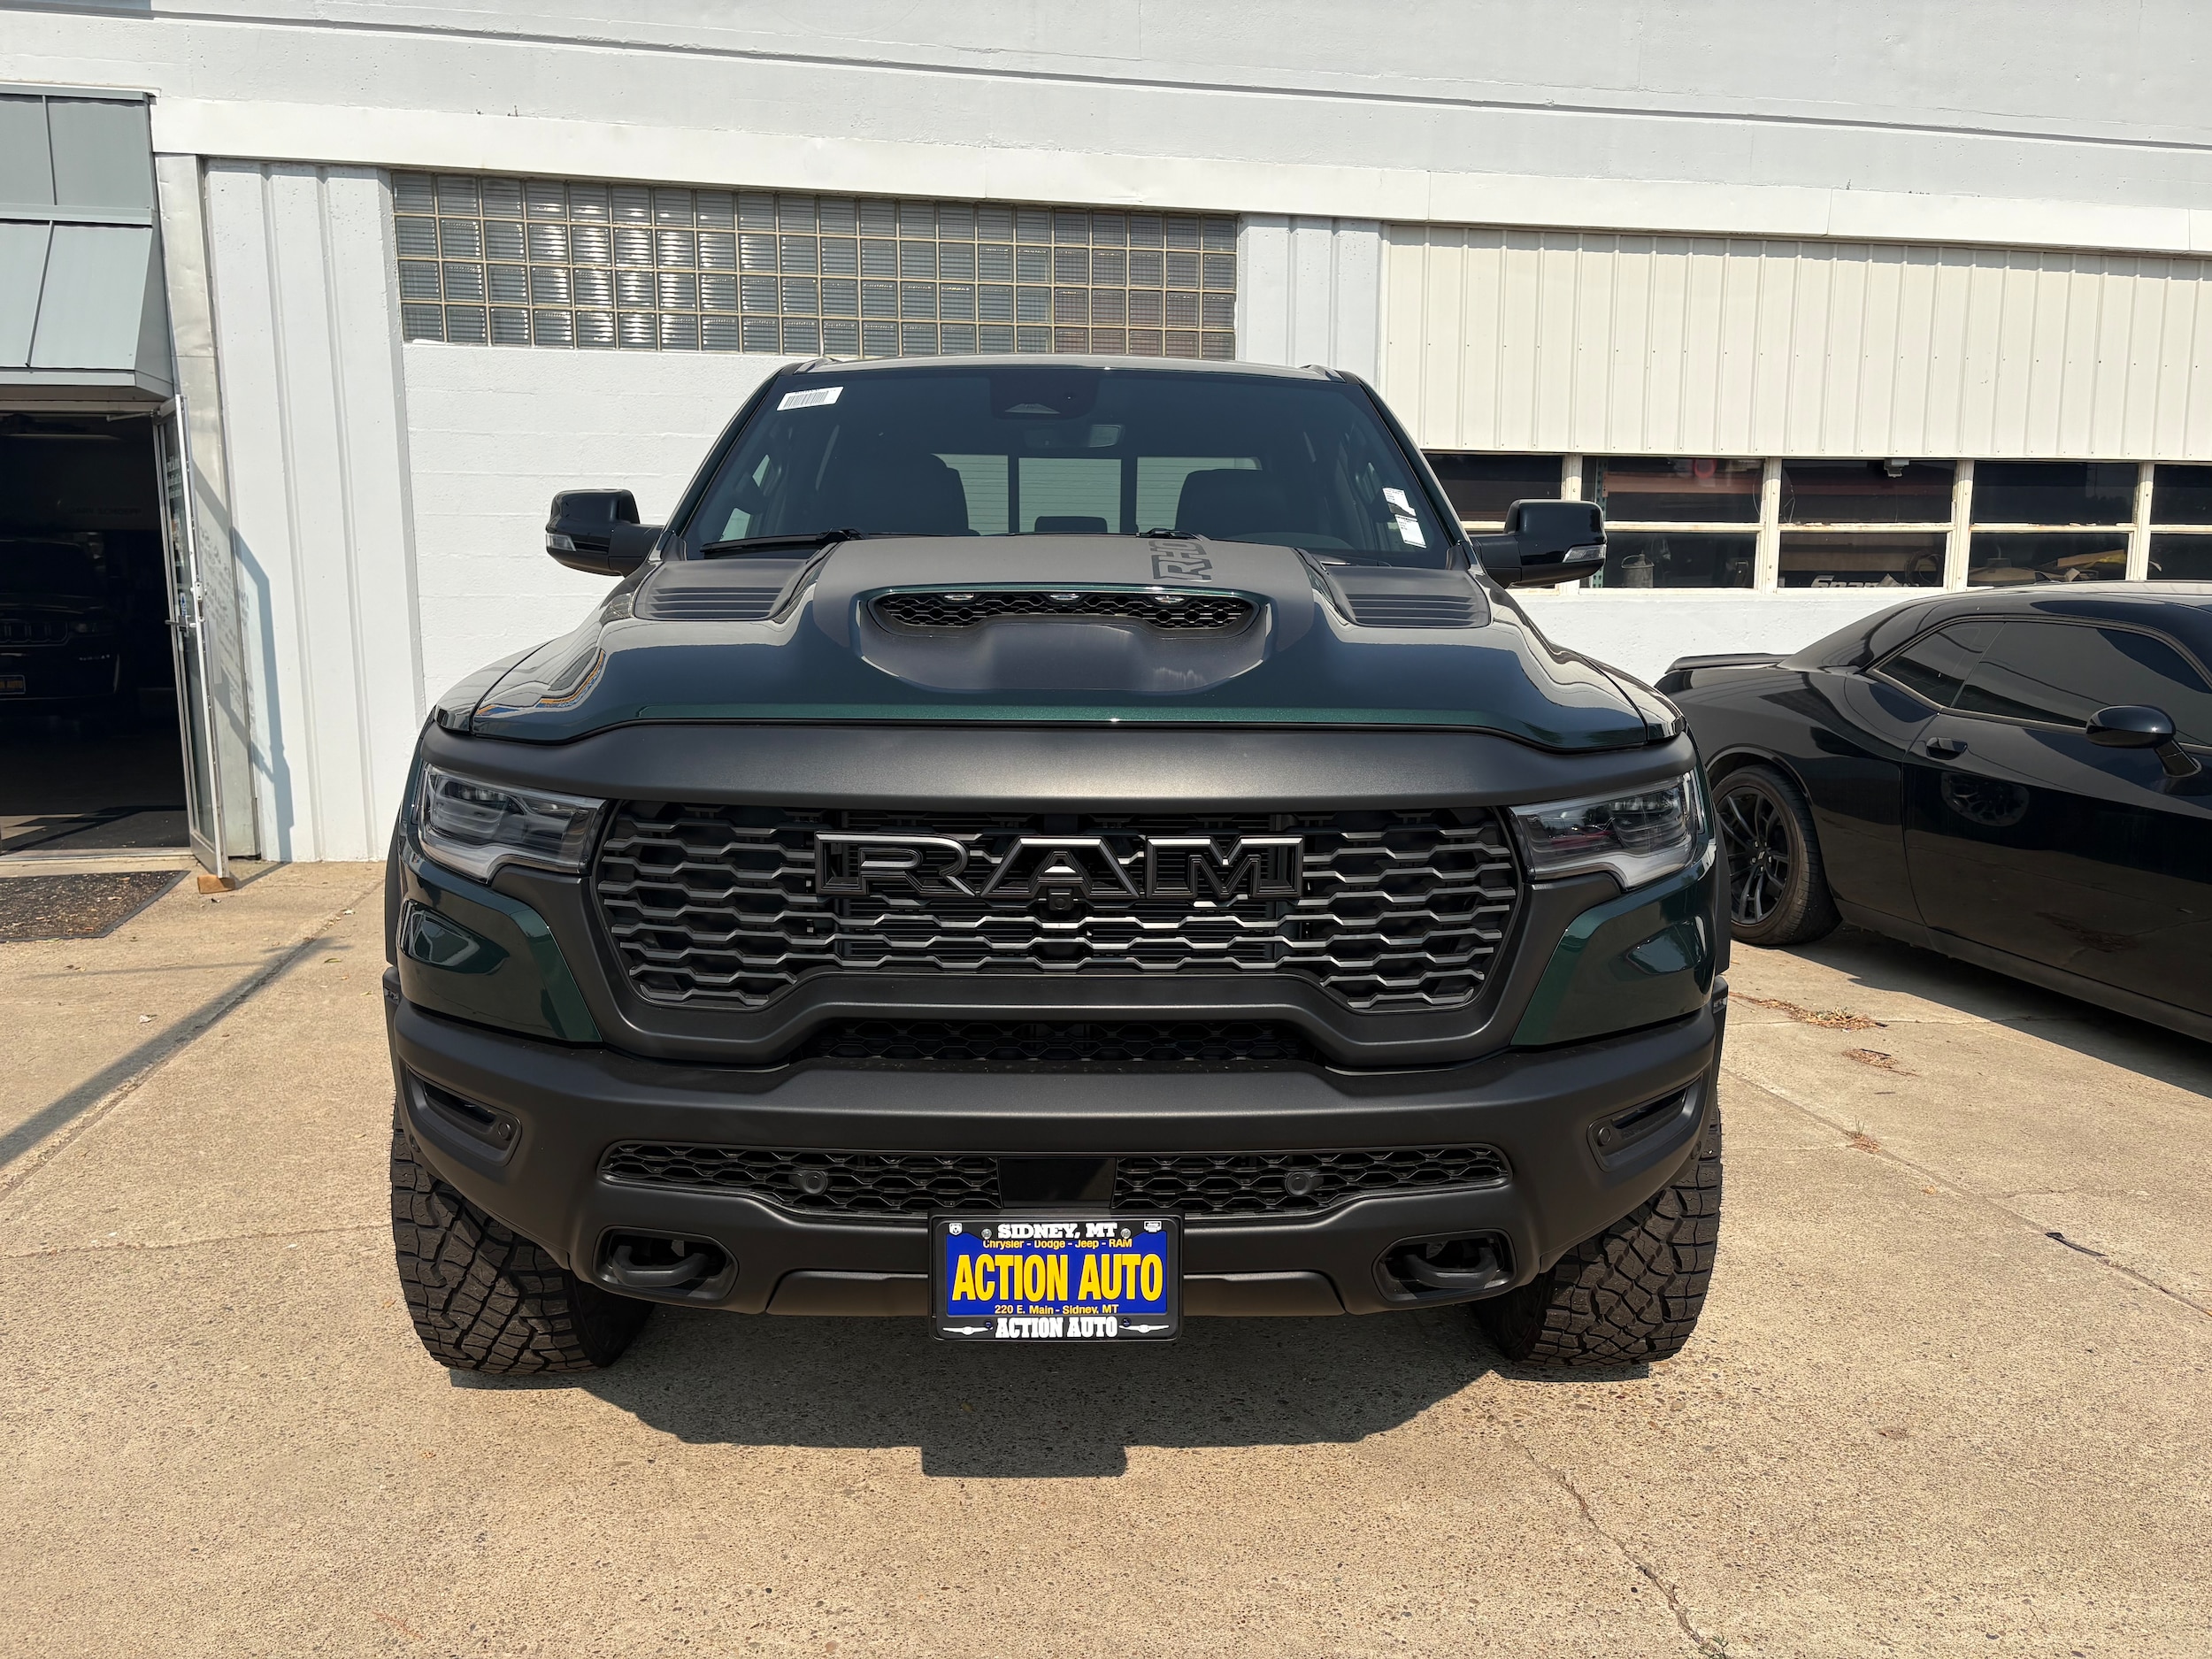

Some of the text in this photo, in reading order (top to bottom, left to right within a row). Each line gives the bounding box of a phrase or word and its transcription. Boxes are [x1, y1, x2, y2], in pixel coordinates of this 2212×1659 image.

[1148, 539, 1213, 580] RHO
[814, 831, 1304, 899] RAM
[997, 1223, 1118, 1239] SIDNEY, MT
[983, 1240, 1025, 1249] Chrysler
[1033, 1240, 1066, 1249] Dodge
[1074, 1240, 1100, 1249] Jeep
[1109, 1239, 1133, 1248] RAM
[952, 1253, 1164, 1302] ACTION AUTO
[994, 1305, 1014, 1314] 220
[1029, 1305, 1054, 1315] Main
[1102, 1304, 1119, 1314] MT
[995, 1316, 1118, 1338] ACTION AUTO
